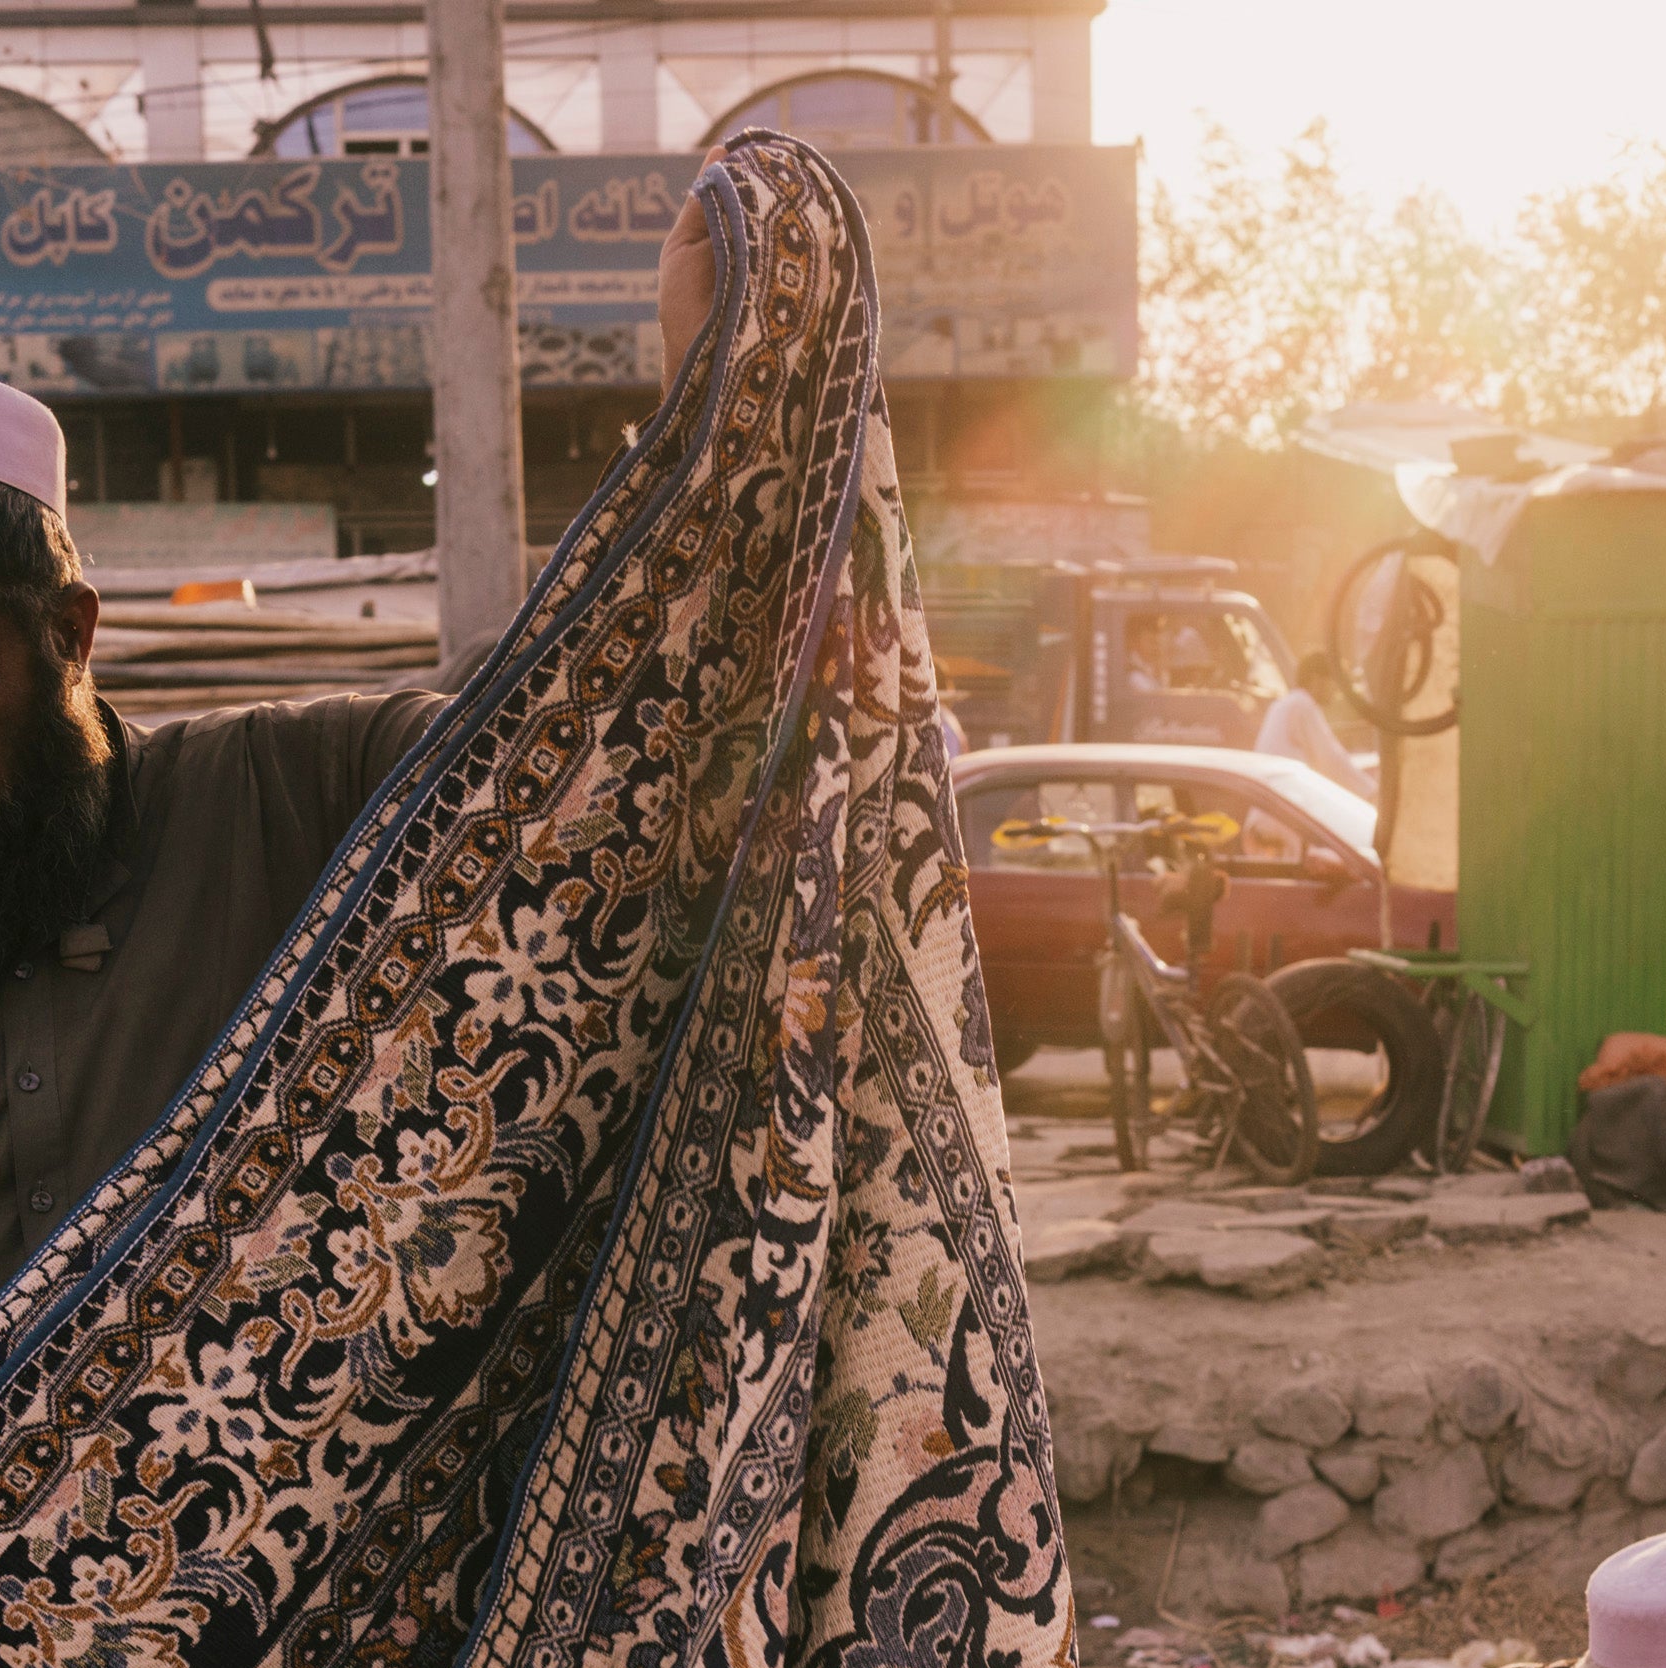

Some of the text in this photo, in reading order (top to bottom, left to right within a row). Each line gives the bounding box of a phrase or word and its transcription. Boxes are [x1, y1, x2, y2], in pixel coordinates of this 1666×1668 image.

[1, 188, 118, 266] کابل
[145, 161, 404, 280] ترکمن
[934, 170, 1070, 238] هوتل
